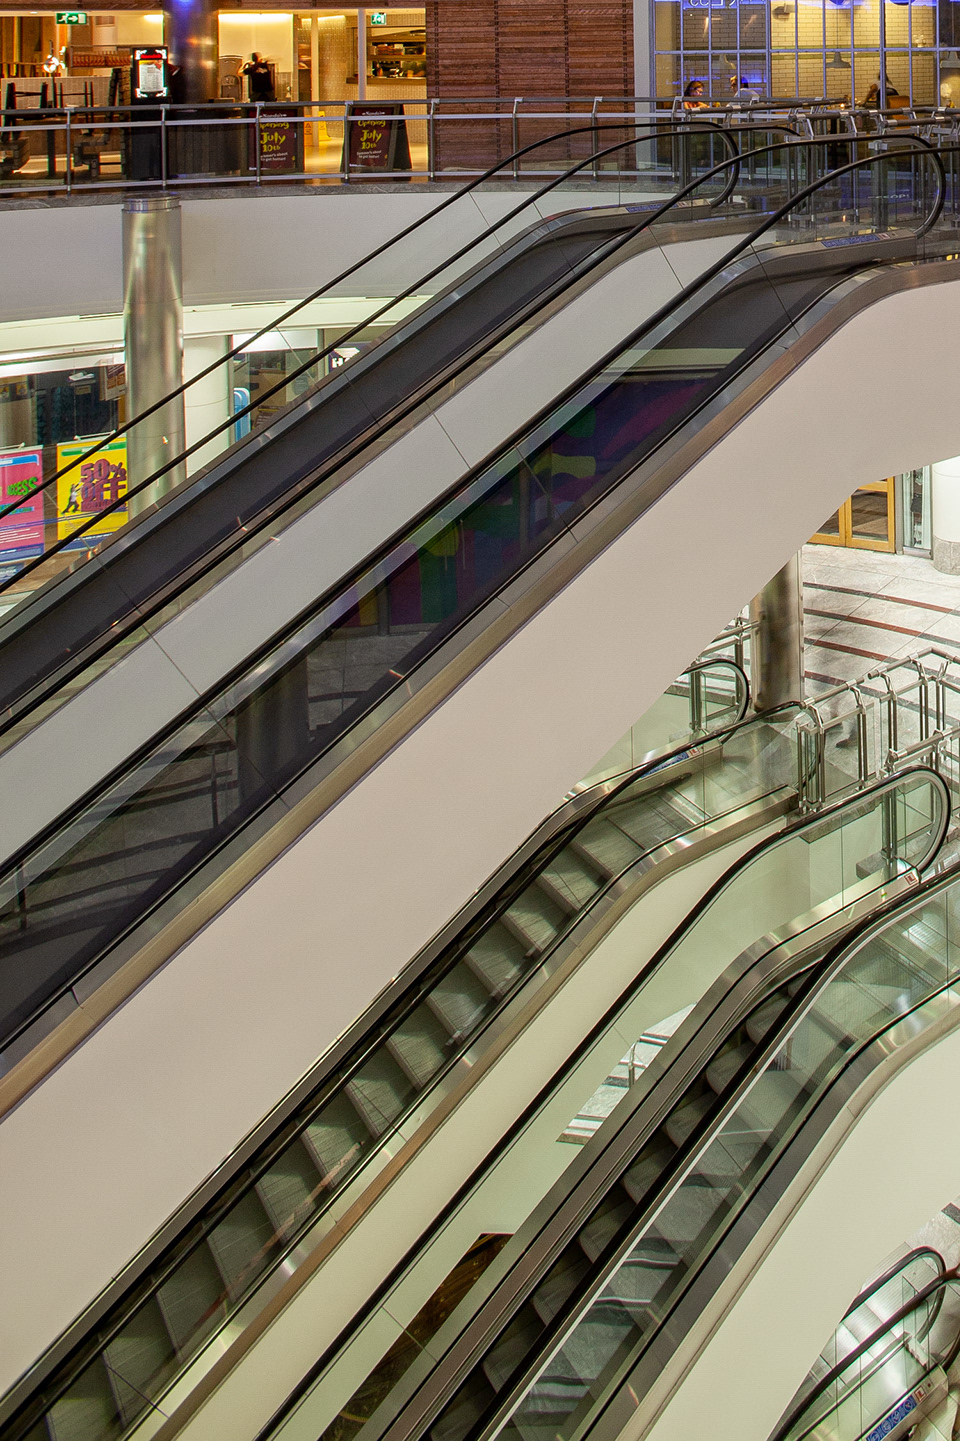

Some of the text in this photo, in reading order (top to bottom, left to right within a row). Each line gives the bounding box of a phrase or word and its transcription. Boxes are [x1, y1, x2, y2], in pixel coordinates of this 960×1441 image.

[255, 122, 290, 130] pening
[260, 132, 286, 145] July
[360, 130, 382, 143] July
[262, 144, 281, 153] 10th
[361, 141, 377, 150] 10th
[81, 458, 127, 482] 50%
[81, 478, 126, 502] OFF
